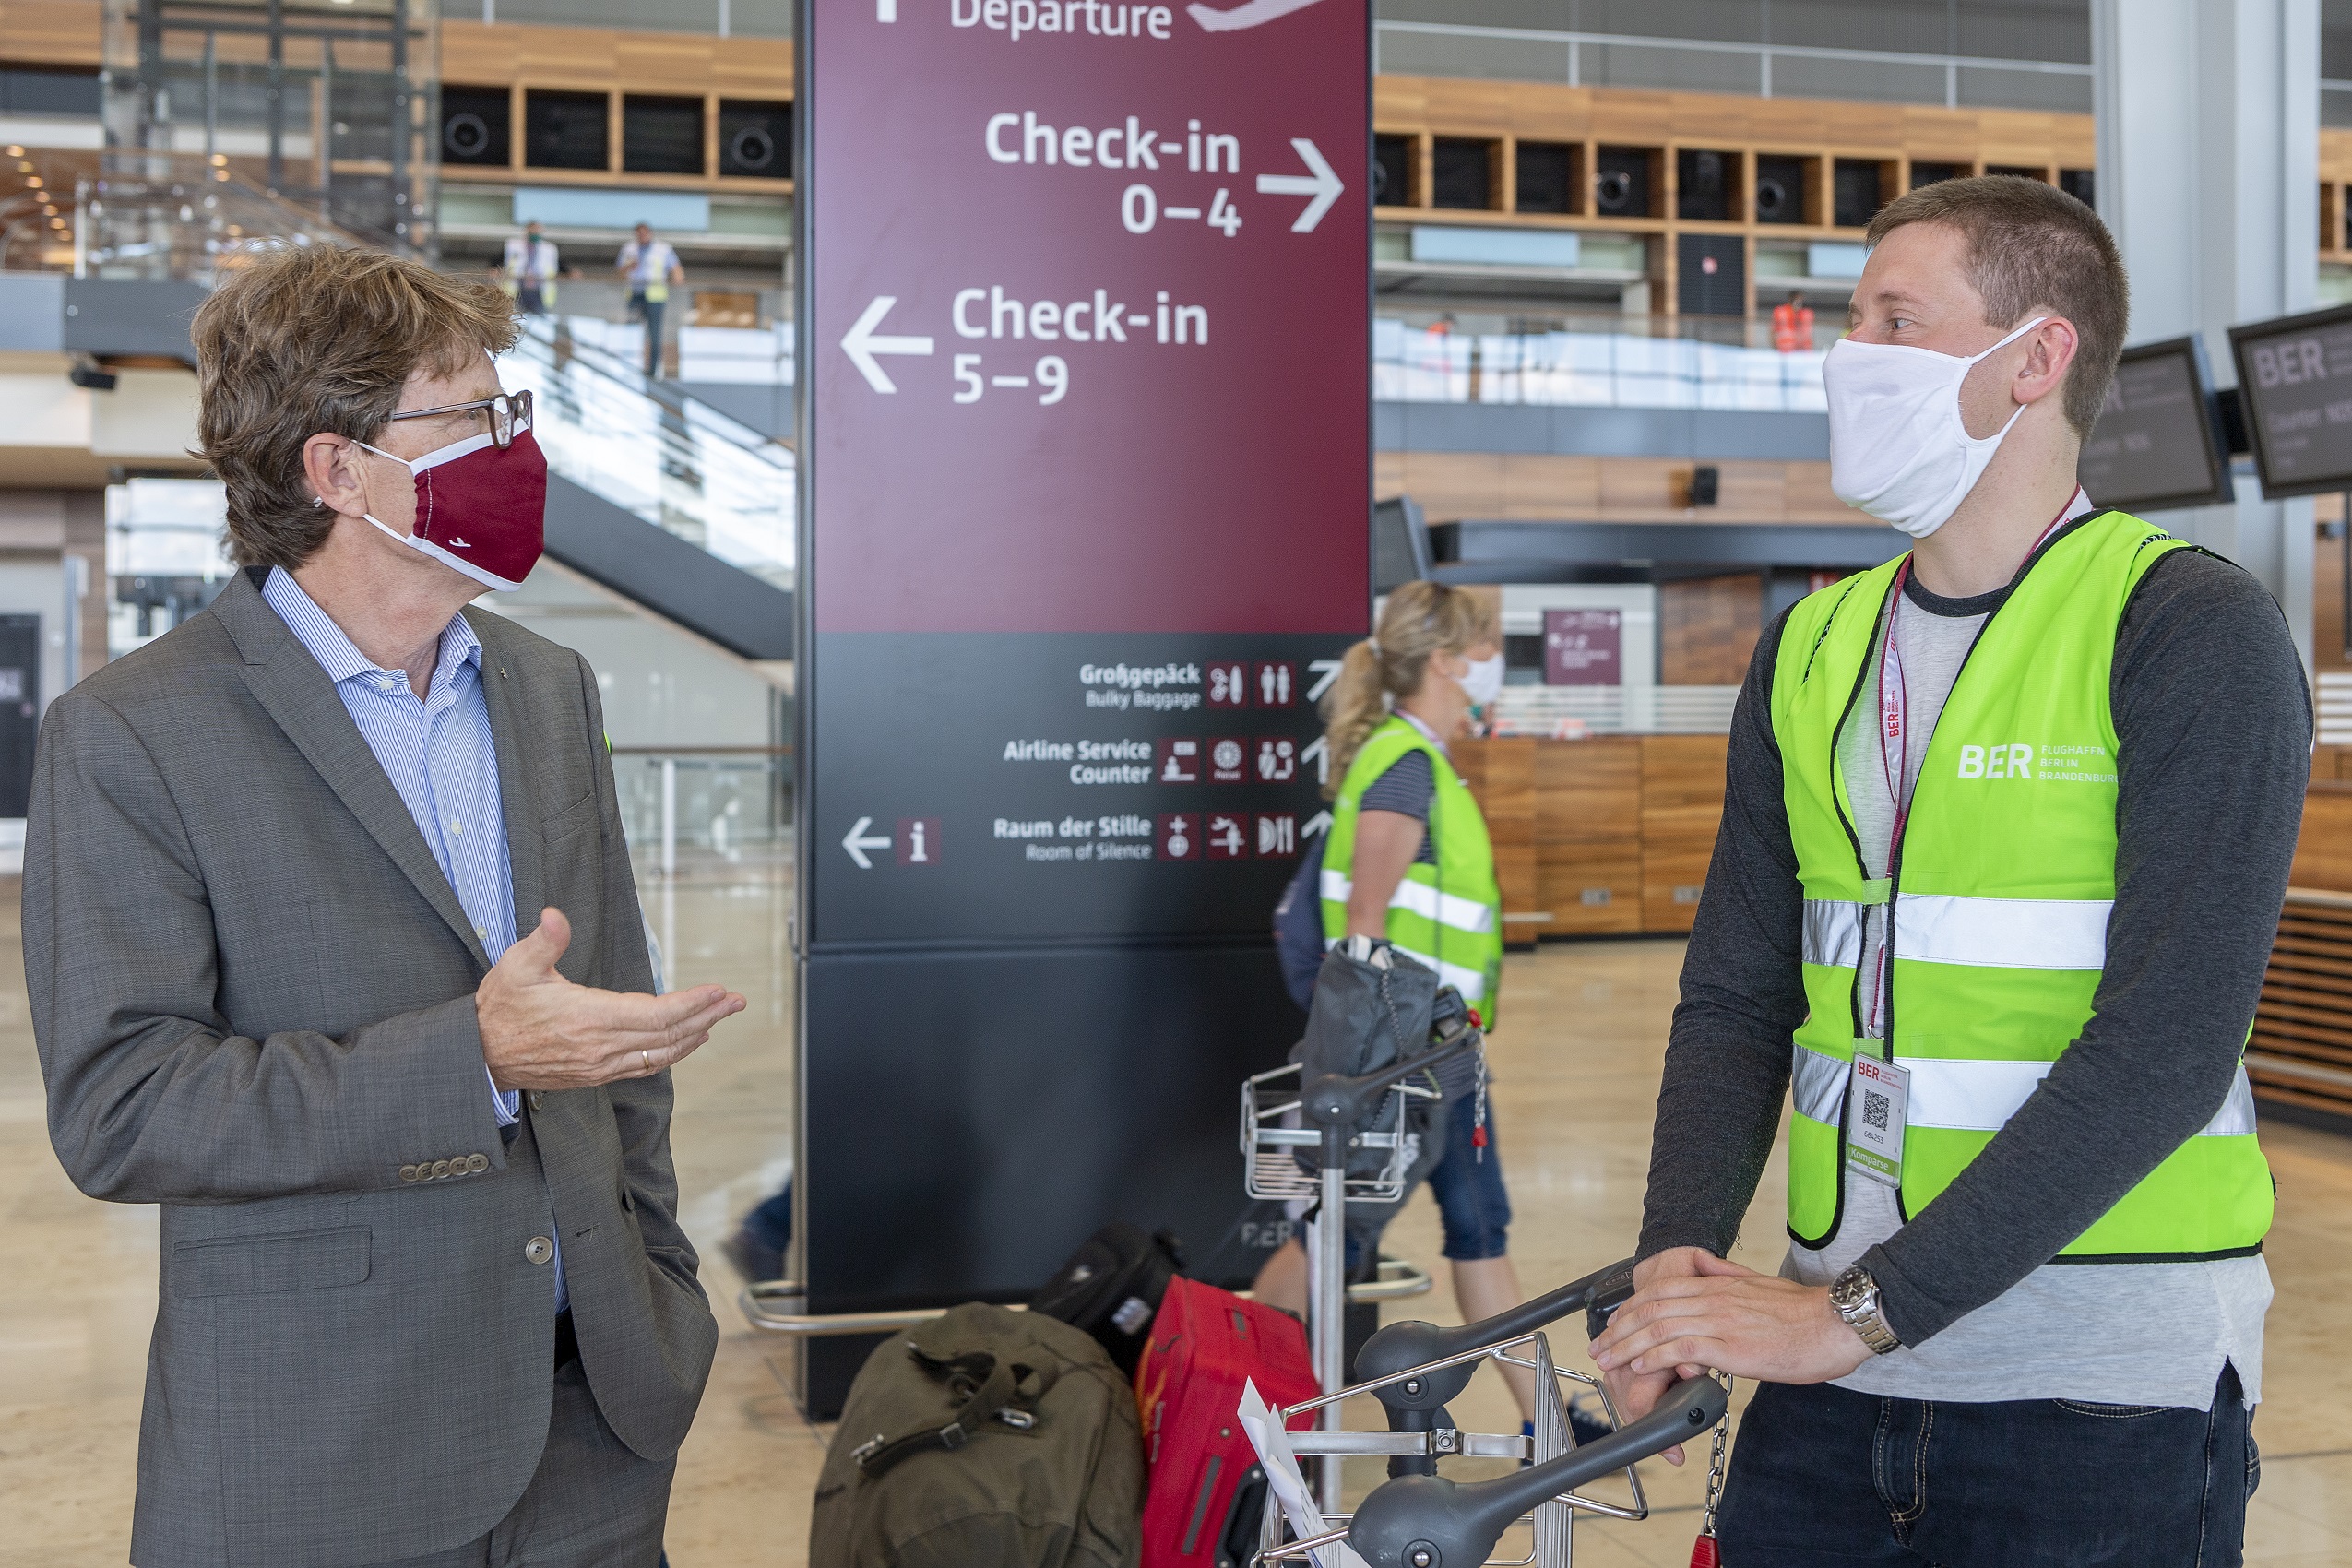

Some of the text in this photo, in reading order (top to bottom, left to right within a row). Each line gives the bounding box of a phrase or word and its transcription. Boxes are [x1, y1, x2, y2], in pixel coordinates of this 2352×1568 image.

[951, 0, 1173, 41] Departure
[985, 111, 1241, 173] Check-in
[953, 286, 1209, 345] Check-in
[2254, 339, 2327, 387] BER
[1079, 662, 1201, 689] Großgepäck
[1086, 689, 1201, 711] Bulky Baggage
[1887, 712, 1900, 738] BER
[1003, 738, 1153, 761] Airline Service
[1957, 743, 2034, 779] BER
[2041, 744, 2106, 755] FLUGHAFEN
[1070, 763, 1153, 784] Counter
[2040, 757, 2079, 767] BERLIN
[993, 814, 1153, 838] Raum der Stille
[1025, 840, 1153, 861] Room of Silence
[1858, 1061, 1880, 1081] BER
[1864, 1130, 1884, 1145] 664253
[1850, 1147, 1889, 1171] Komparse
